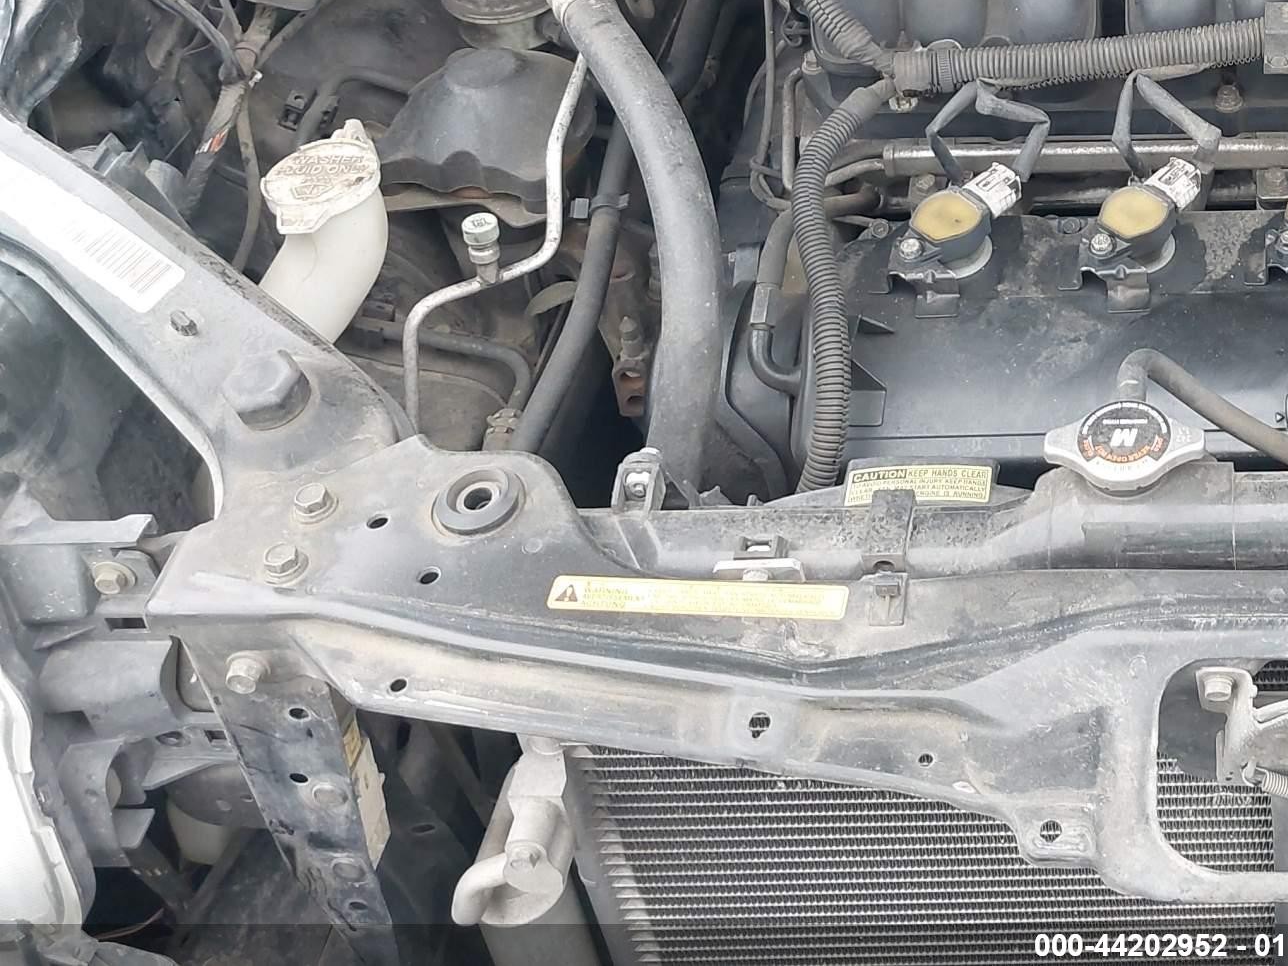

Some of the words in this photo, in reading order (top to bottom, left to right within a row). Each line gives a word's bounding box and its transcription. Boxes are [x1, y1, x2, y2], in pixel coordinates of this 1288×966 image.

[853, 469, 906, 483] CAUTION
[908, 469, 928, 478] KEEP
[931, 469, 958, 478] HANDS
[960, 470, 987, 479] CLEAR
